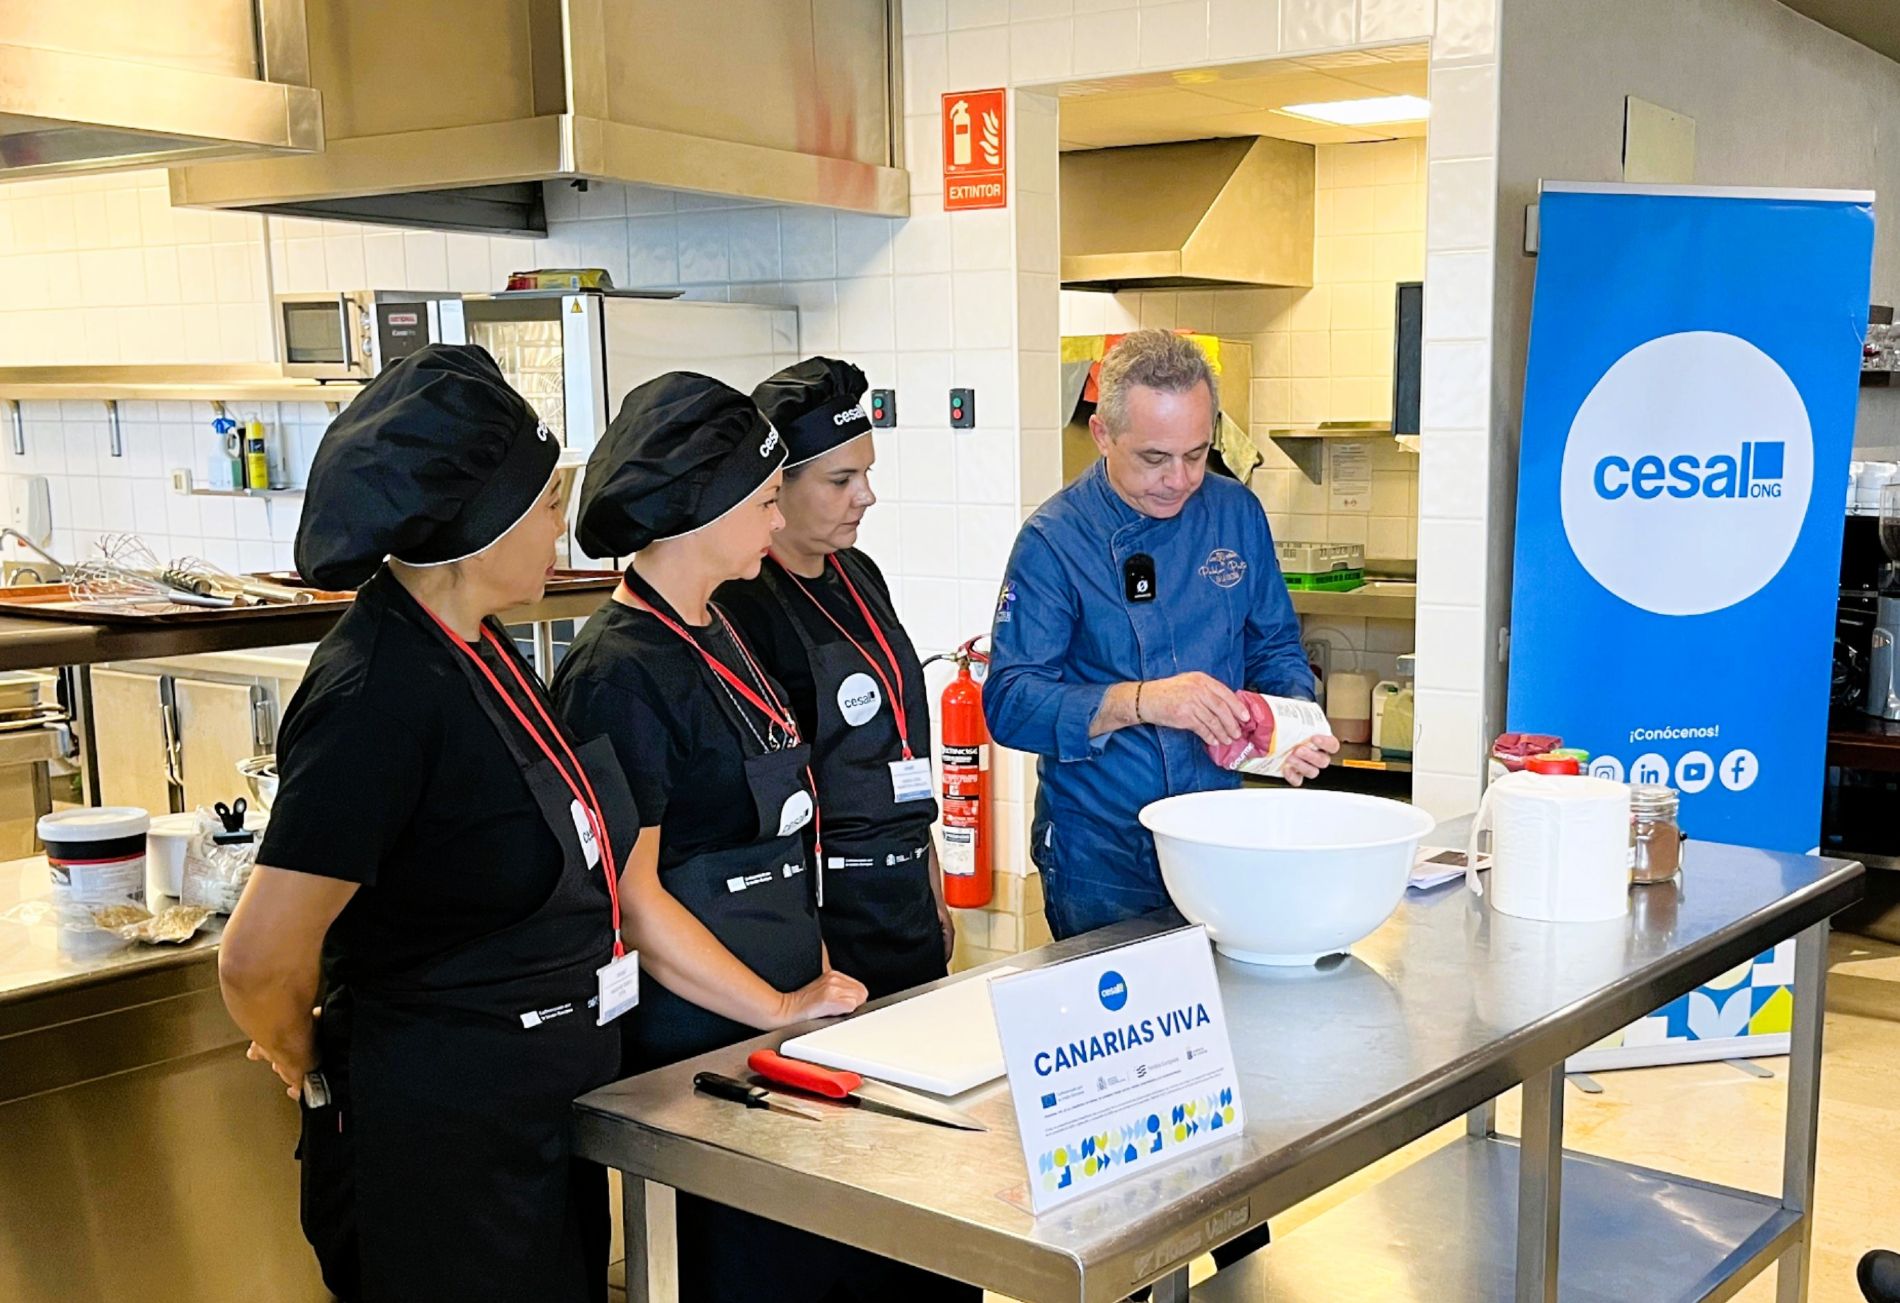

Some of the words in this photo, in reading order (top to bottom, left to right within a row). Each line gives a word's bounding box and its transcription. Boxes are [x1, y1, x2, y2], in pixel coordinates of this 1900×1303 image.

[949, 184, 1001, 200] EXTINTOR
[1593, 441, 1752, 501] cesal
[1750, 484, 1782, 499] ONG
[1629, 724, 1720, 744] ¡Conócenos!
[1034, 1019, 1155, 1077] CANARIAS
[1157, 1003, 1211, 1037] VIVA
